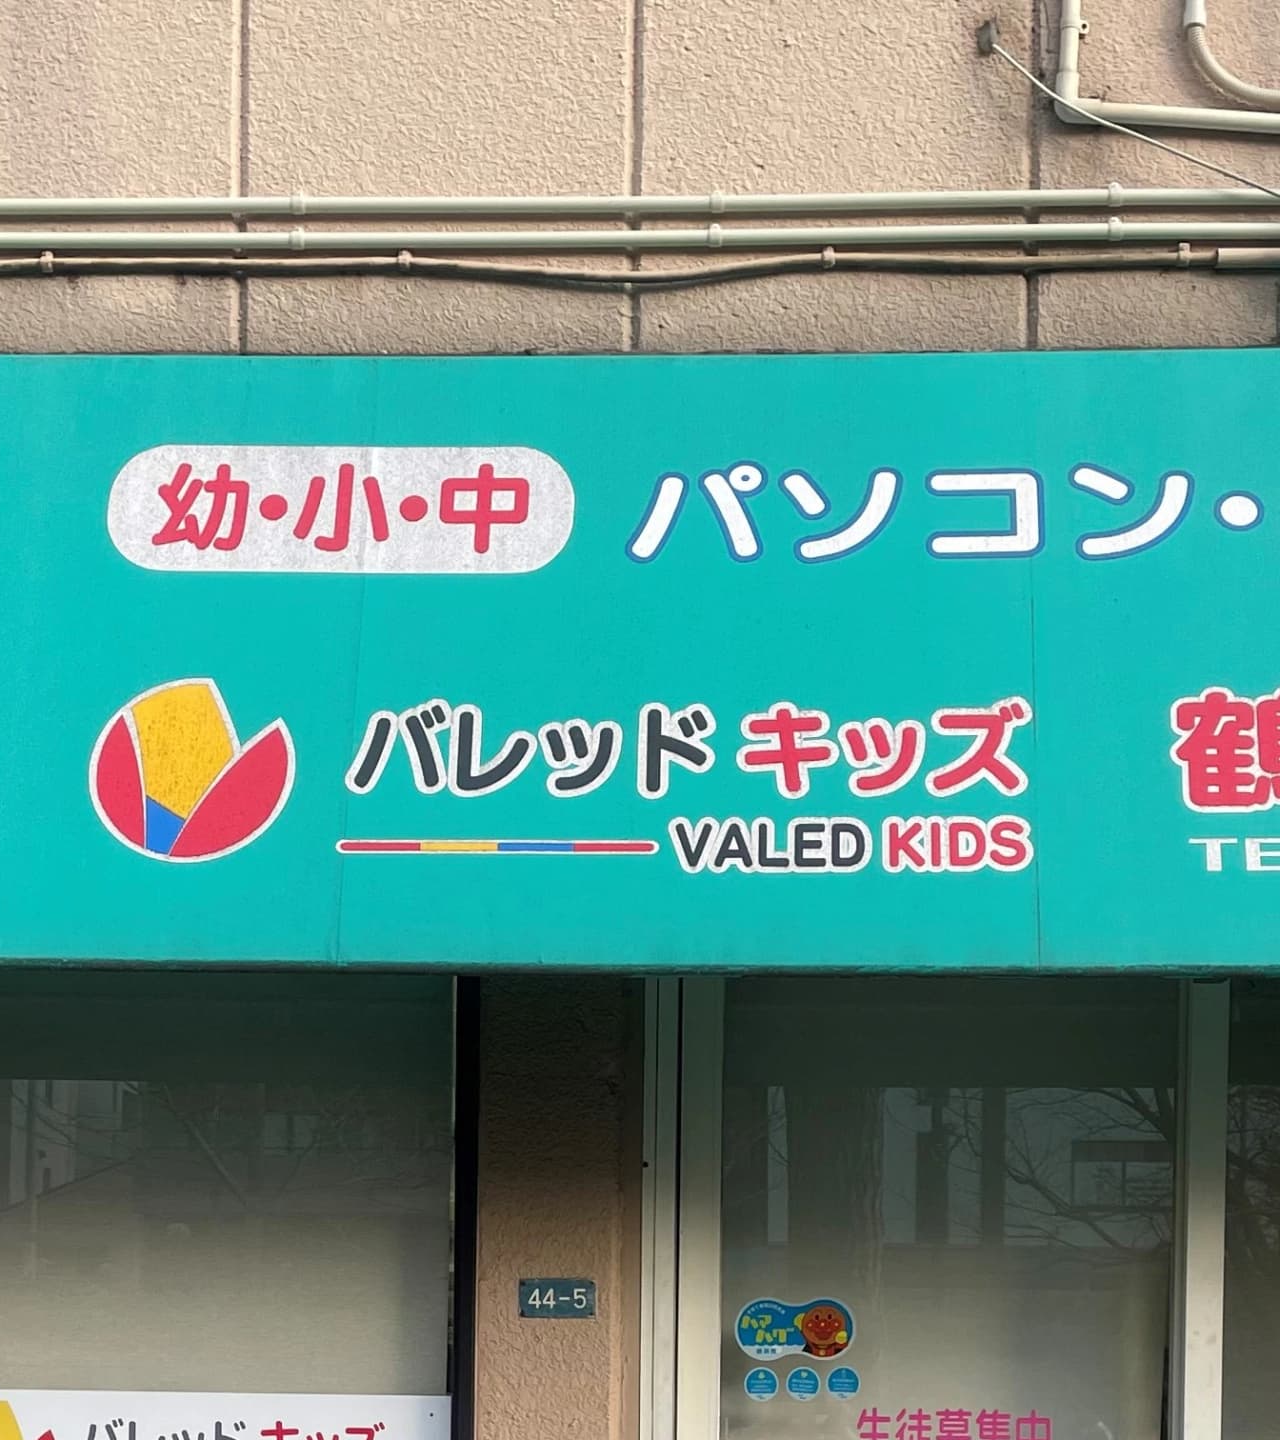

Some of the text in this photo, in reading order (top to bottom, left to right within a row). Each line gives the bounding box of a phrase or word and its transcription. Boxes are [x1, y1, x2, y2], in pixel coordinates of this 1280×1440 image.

[152, 462, 530, 554] 幼・小・中
[347, 697, 1031, 798] バレッド キッズ
[671, 817, 1031, 870] VALED KIDS
[528, 1288, 587, 1309] 44-5
